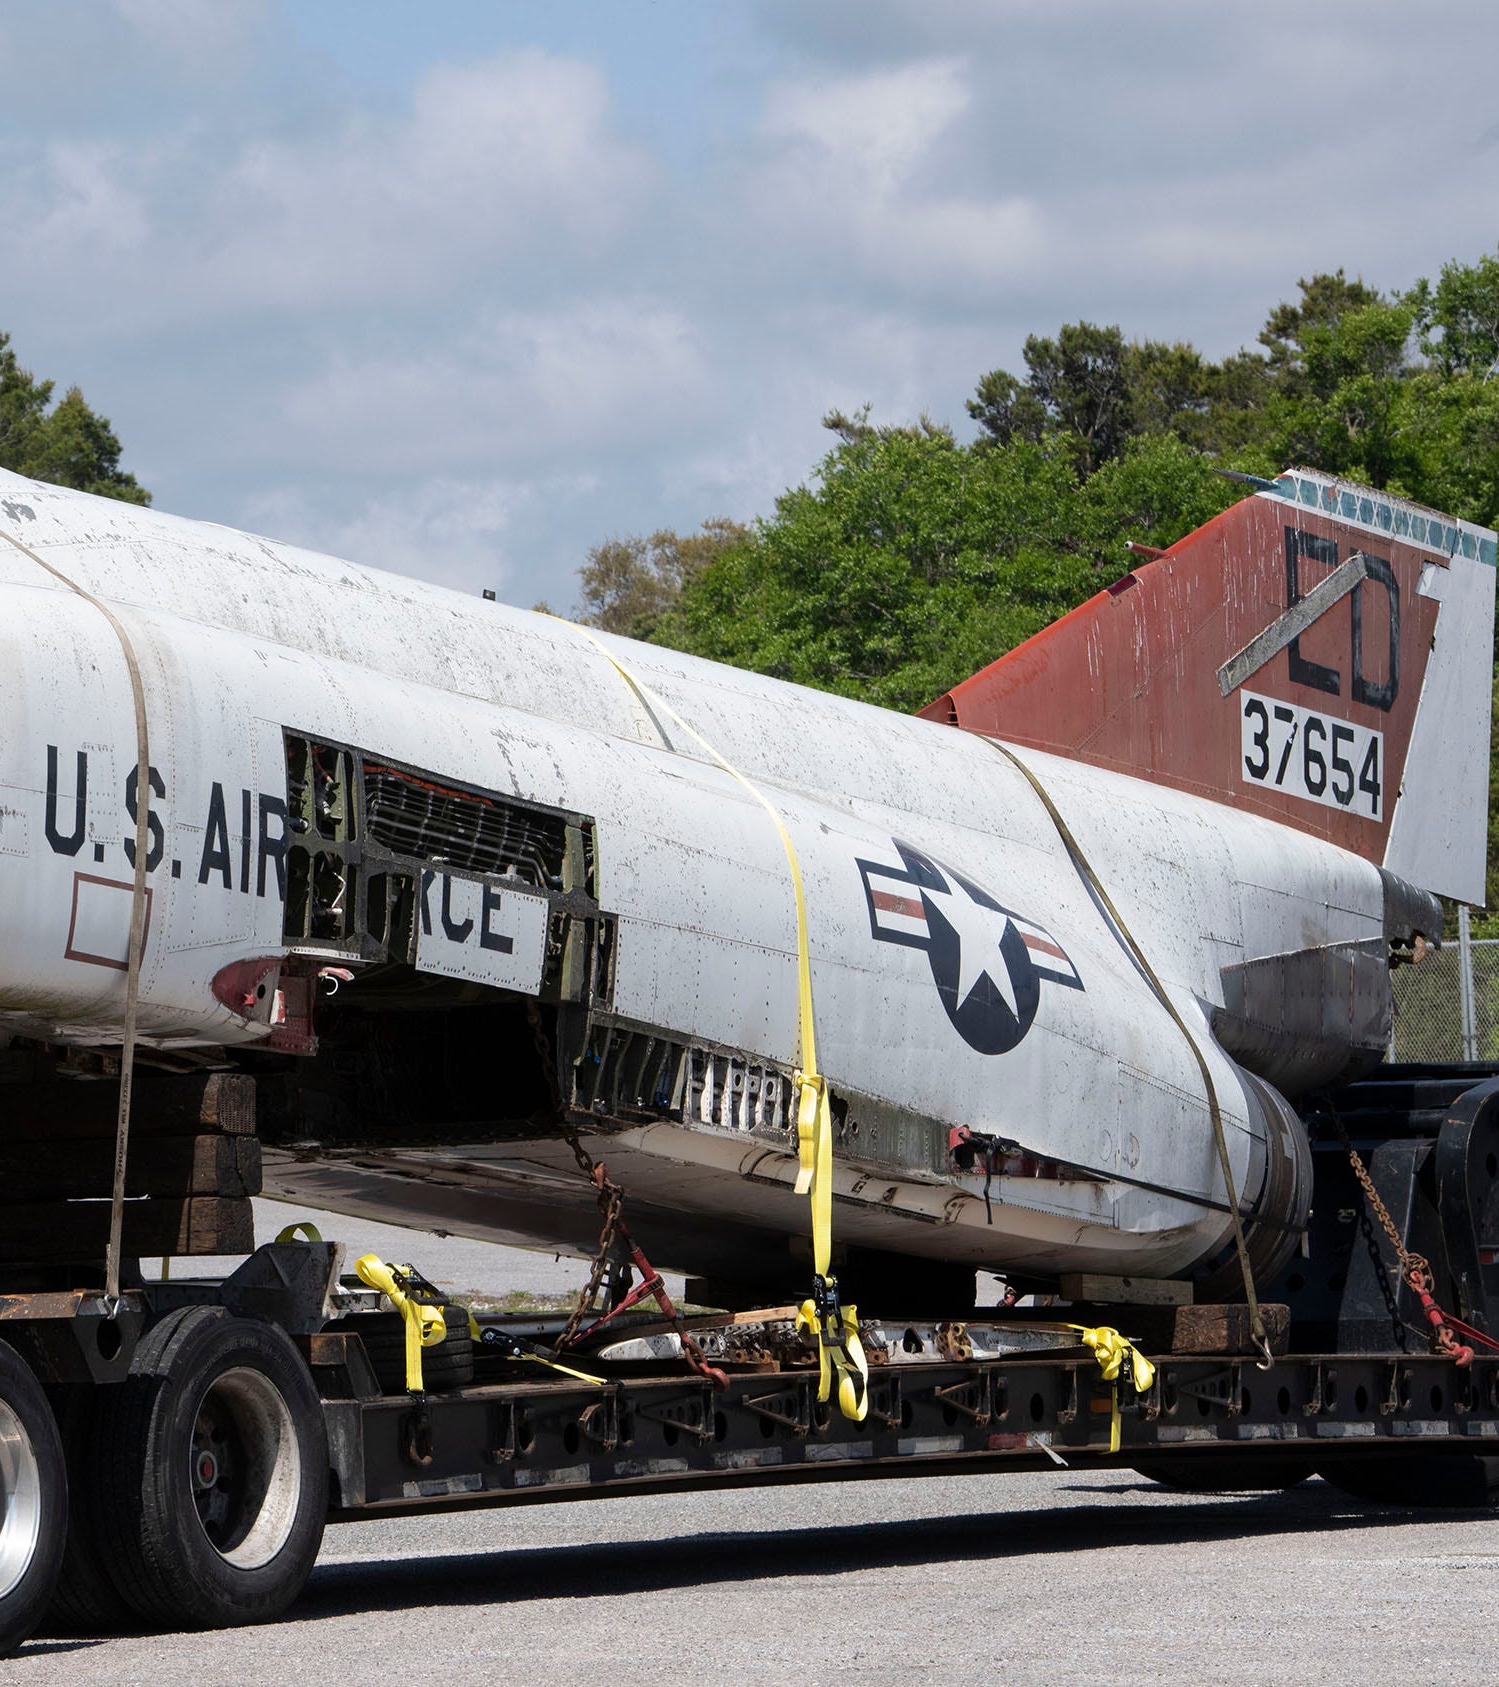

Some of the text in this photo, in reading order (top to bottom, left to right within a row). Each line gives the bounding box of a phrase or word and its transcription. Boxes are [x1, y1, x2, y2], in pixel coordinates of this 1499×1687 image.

[1284, 525, 1399, 713] ED
[45, 744, 181, 880] U.S.
[198, 782, 288, 902] AIR
[1244, 698, 1380, 815] 37654
